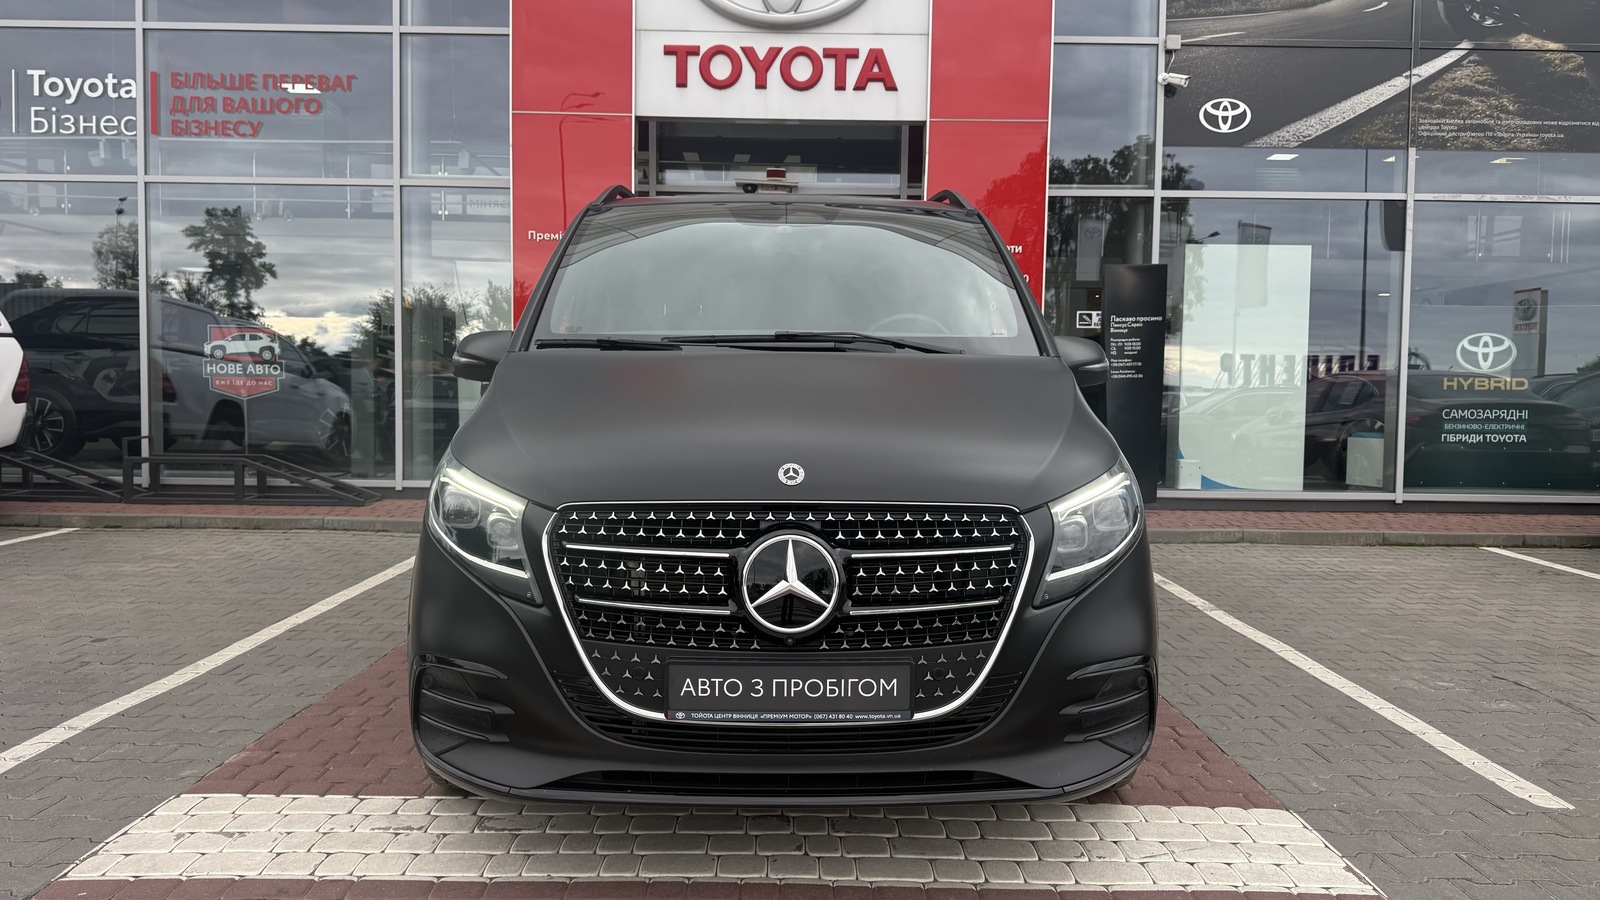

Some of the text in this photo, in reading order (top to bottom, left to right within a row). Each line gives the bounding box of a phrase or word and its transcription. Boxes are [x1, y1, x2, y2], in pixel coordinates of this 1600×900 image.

[663, 44, 899, 91] TOYOTA
[27, 69, 136, 104] Toyota
[170, 71, 356, 93] БІЛЬШЕ ПЕРЕВАГ
[169, 96, 322, 116] ДЛЯ ВАШОГО
[30, 106, 136, 135] Бізнес
[170, 119, 264, 137] БІЗНЕСУ
[206, 363, 280, 375] НОВЕ АВТО
[1443, 377, 1530, 391] HYBRID
[1442, 409, 1529, 421] САМОЗАРЯДНІ
[1441, 433, 1527, 444] ГІБРИДИ TOYOTA
[680, 678, 743, 697] АВТО
[772, 678, 898, 698] ПРОБІГОМ
